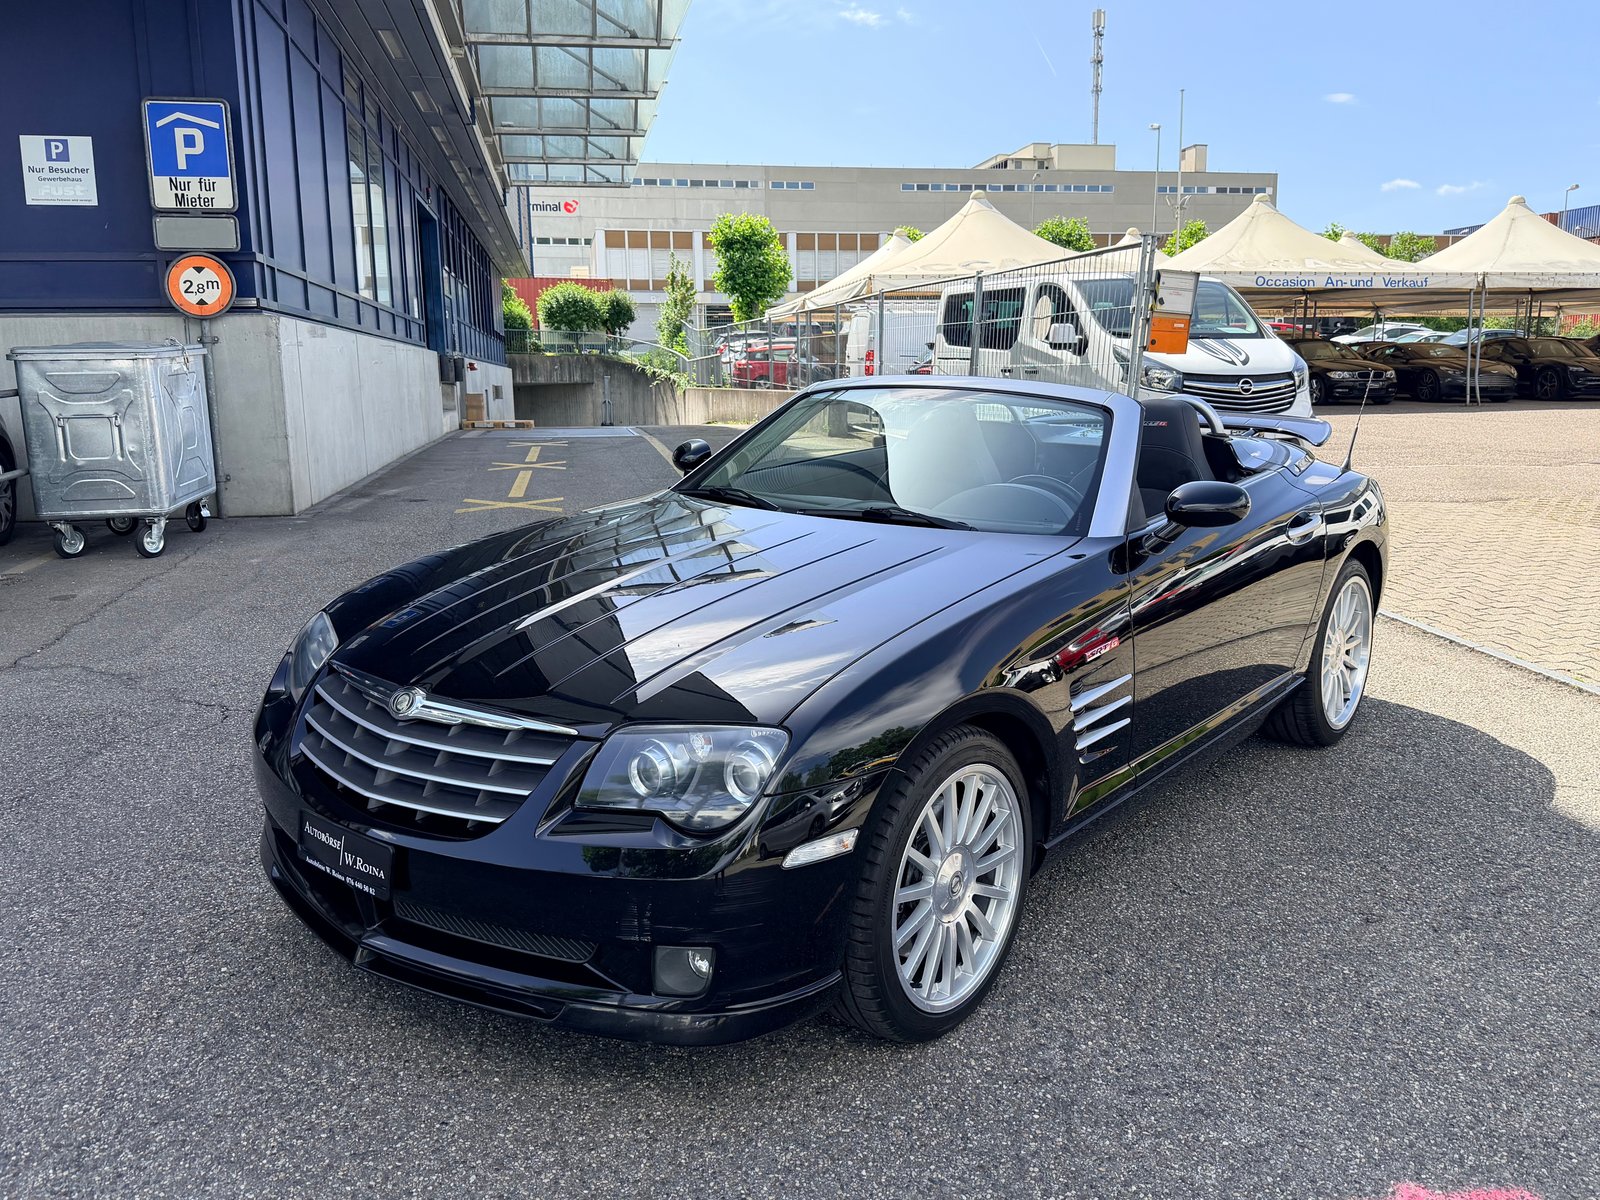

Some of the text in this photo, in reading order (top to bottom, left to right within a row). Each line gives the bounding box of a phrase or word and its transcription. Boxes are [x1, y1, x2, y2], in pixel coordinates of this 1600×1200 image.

[50, 141, 64, 160] P
[174, 127, 204, 170] P
[28, 165, 90, 174] Nur Besucher
[168, 176, 216, 192] Nur für
[174, 193, 215, 207] Mieter
[530, 201, 561, 212] minal
[1255, 275, 1315, 288] Occasion
[1383, 276, 1428, 288] Verkauf
